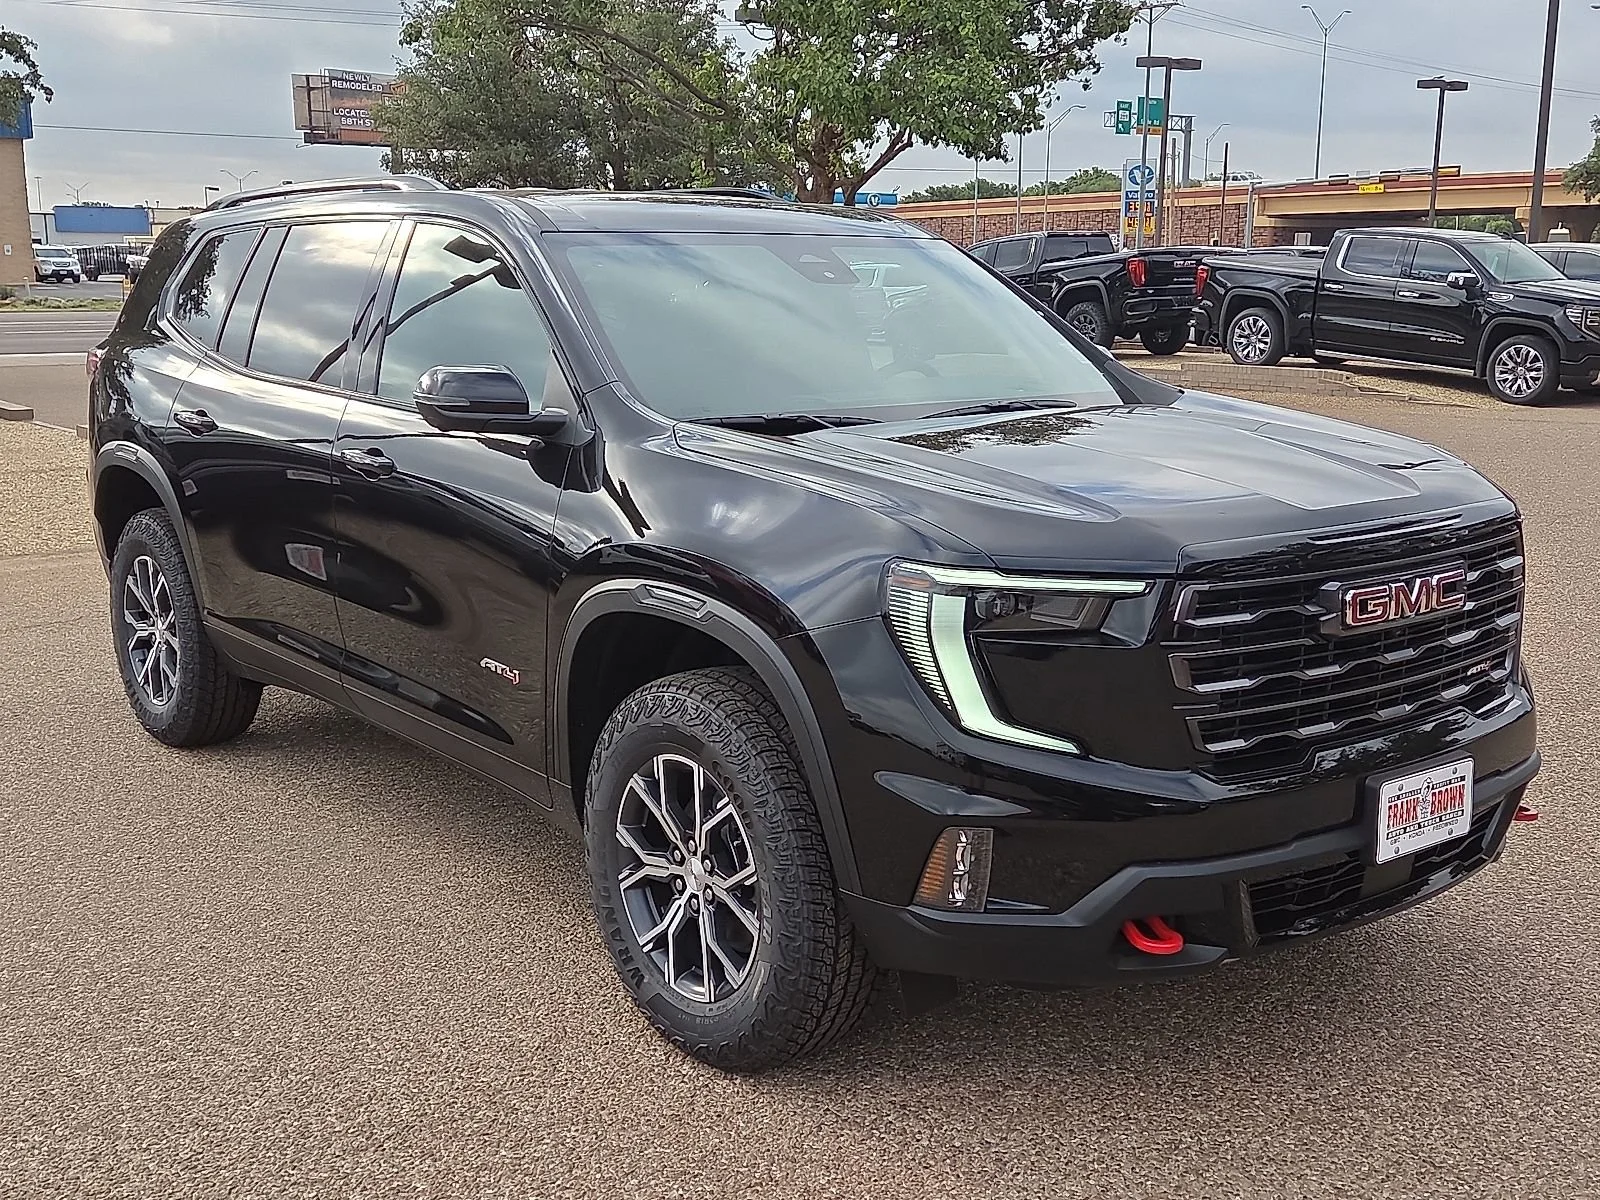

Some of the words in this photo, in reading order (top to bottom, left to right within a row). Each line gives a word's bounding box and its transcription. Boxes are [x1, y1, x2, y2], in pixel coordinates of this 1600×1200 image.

[343, 72, 371, 81] NEWLY
[331, 81, 383, 92] REMODELED
[341, 117, 364, 127] 58TH
[1127, 191, 1154, 199] Valro
[1345, 569, 1466, 626] GMC
[480, 657, 520, 685] AT4
[1387, 797, 1420, 830] FRANK
[1430, 784, 1466, 817] BROWN
